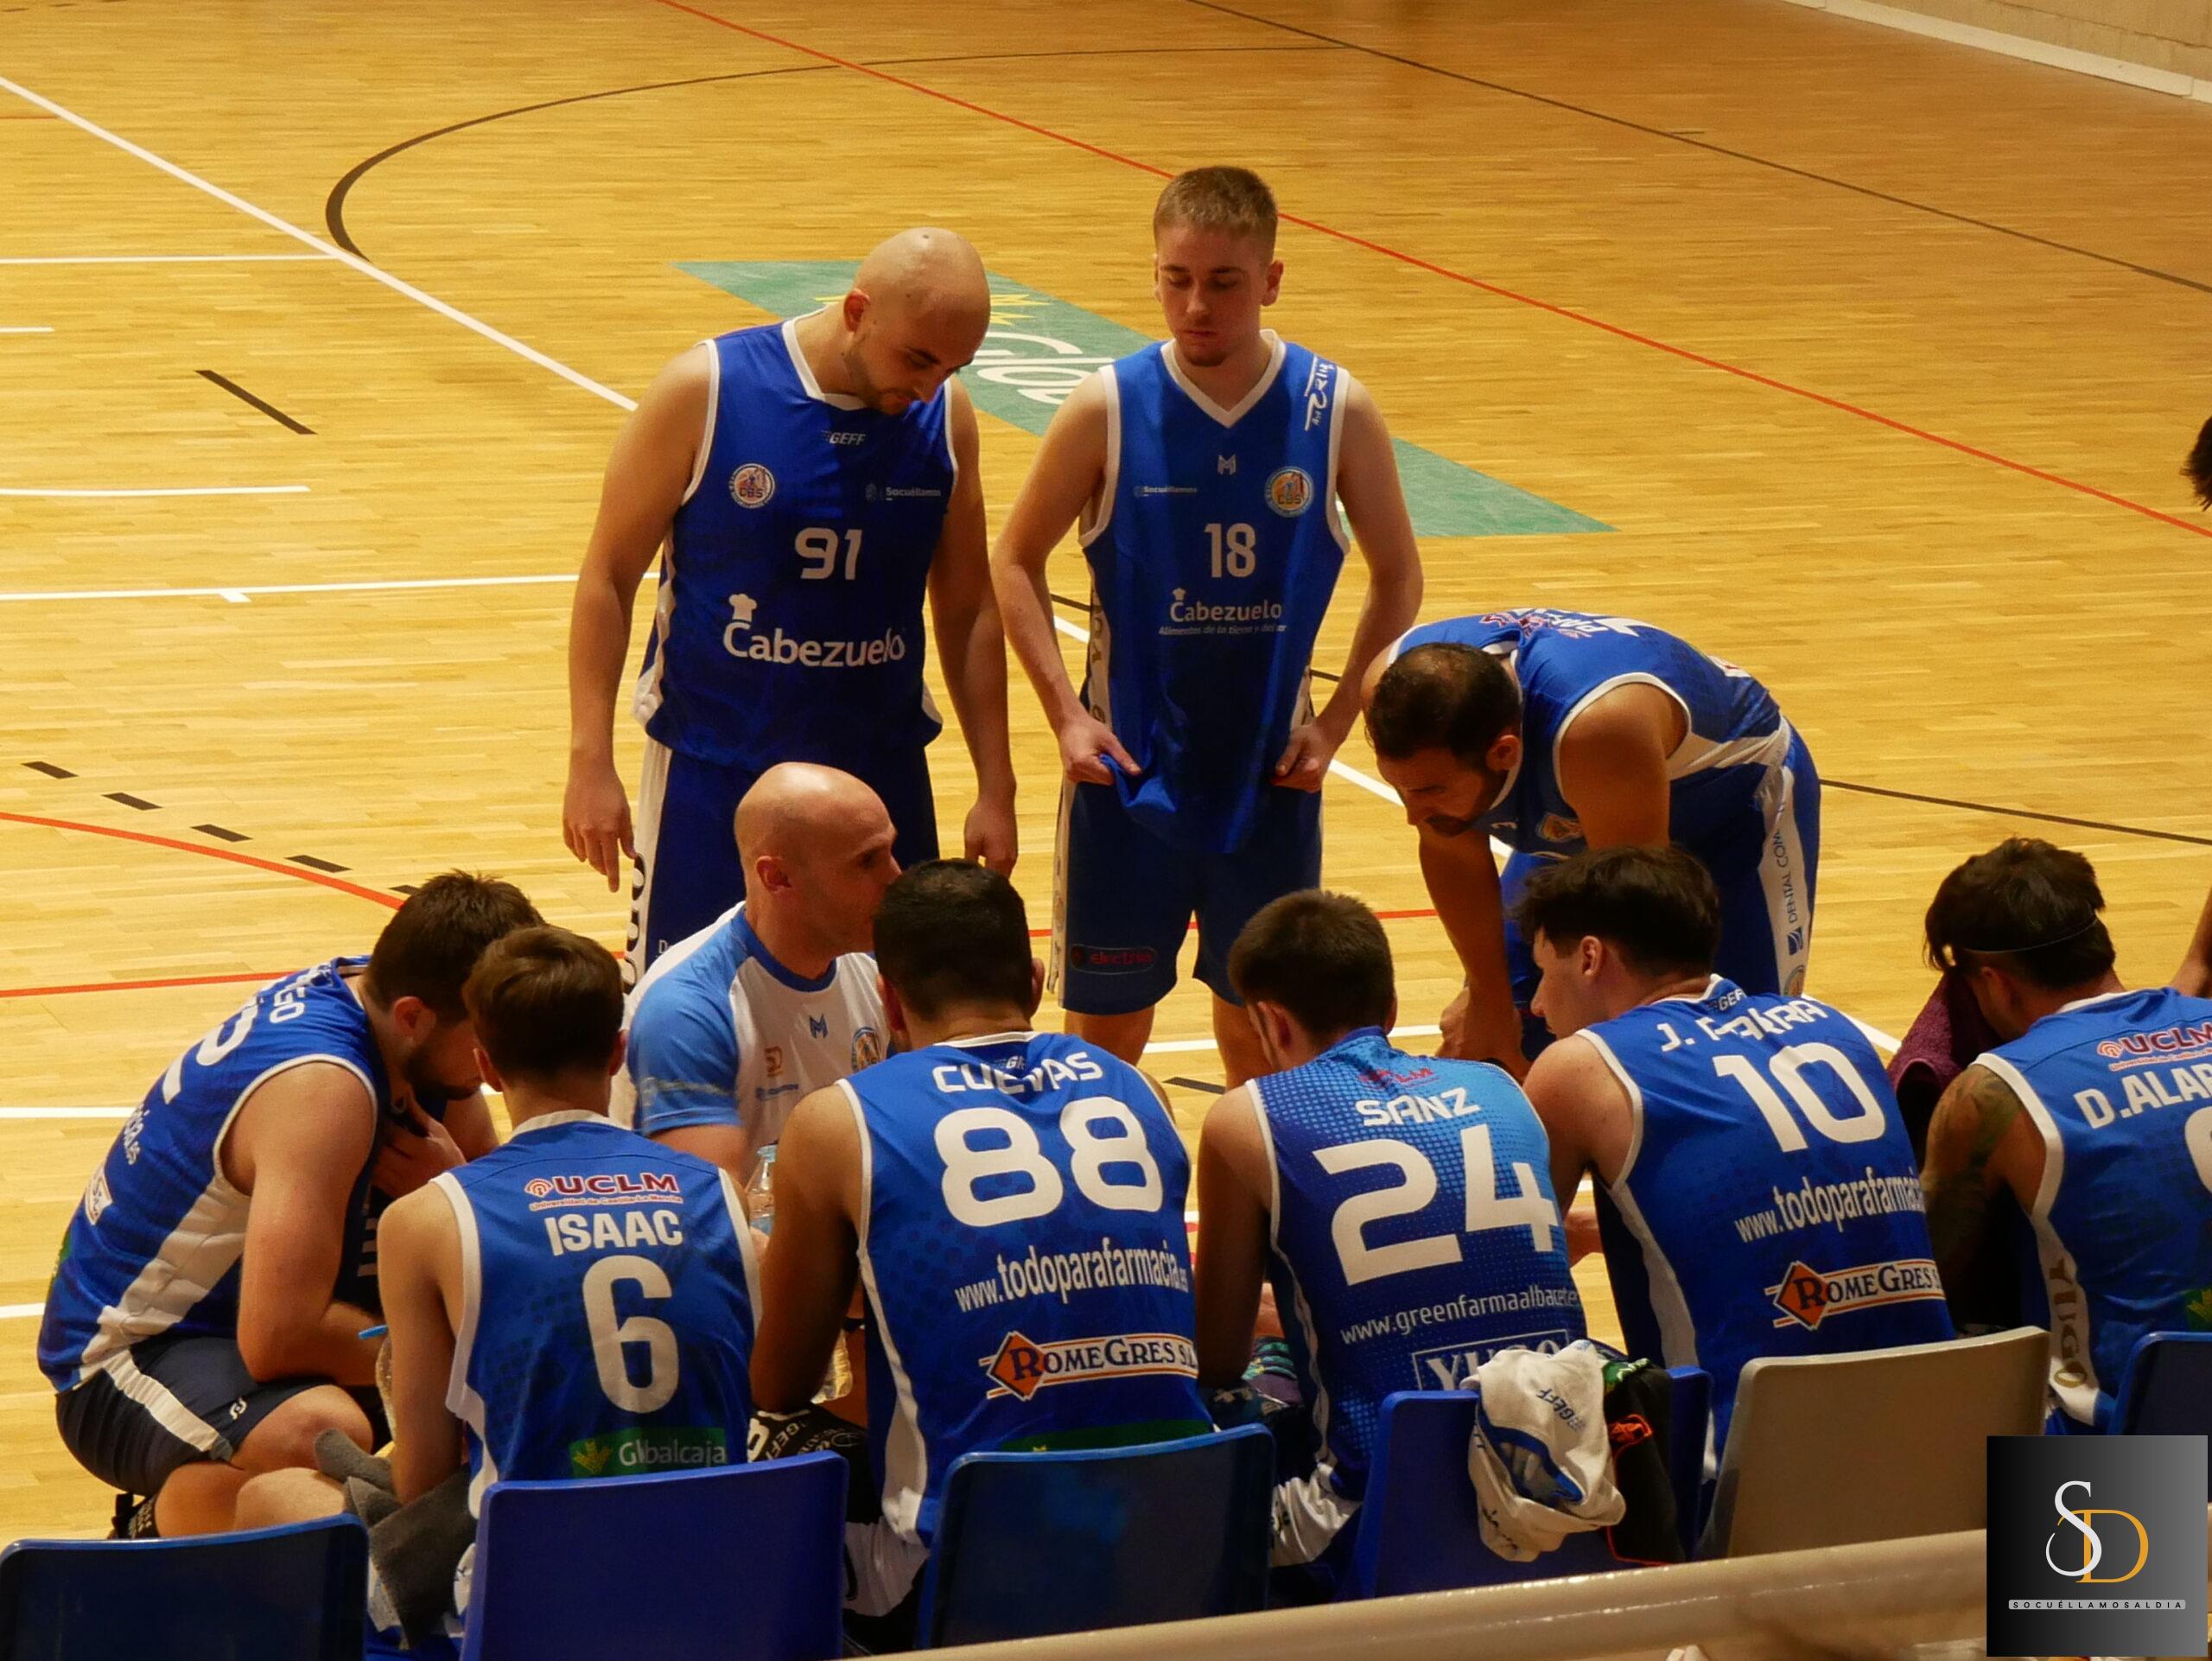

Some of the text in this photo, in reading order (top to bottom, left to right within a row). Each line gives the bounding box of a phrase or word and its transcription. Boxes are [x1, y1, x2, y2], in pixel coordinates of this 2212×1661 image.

[828, 431, 866, 445] GEFF
[794, 527, 863, 581] 91
[1205, 523, 1256, 578] 18
[1169, 598, 1283, 623] Cabezuelo
[722, 619, 906, 668] Cabezuelo
[1772, 827, 1798, 924] DENTAL COM
[1656, 1022, 1694, 1052] J.
[932, 1051, 1103, 1095] CUEVAS
[1354, 1086, 1482, 1127] SANZ
[1713, 1042, 1886, 1154] 10
[550, 1171, 682, 1196] UCLM
[933, 1096, 1164, 1227] 88
[1312, 1123, 1559, 1287] 24
[543, 1209, 684, 1257] ISAAC
[582, 1255, 679, 1414] 6
[1535, 1387, 1575, 1422] GEFF
